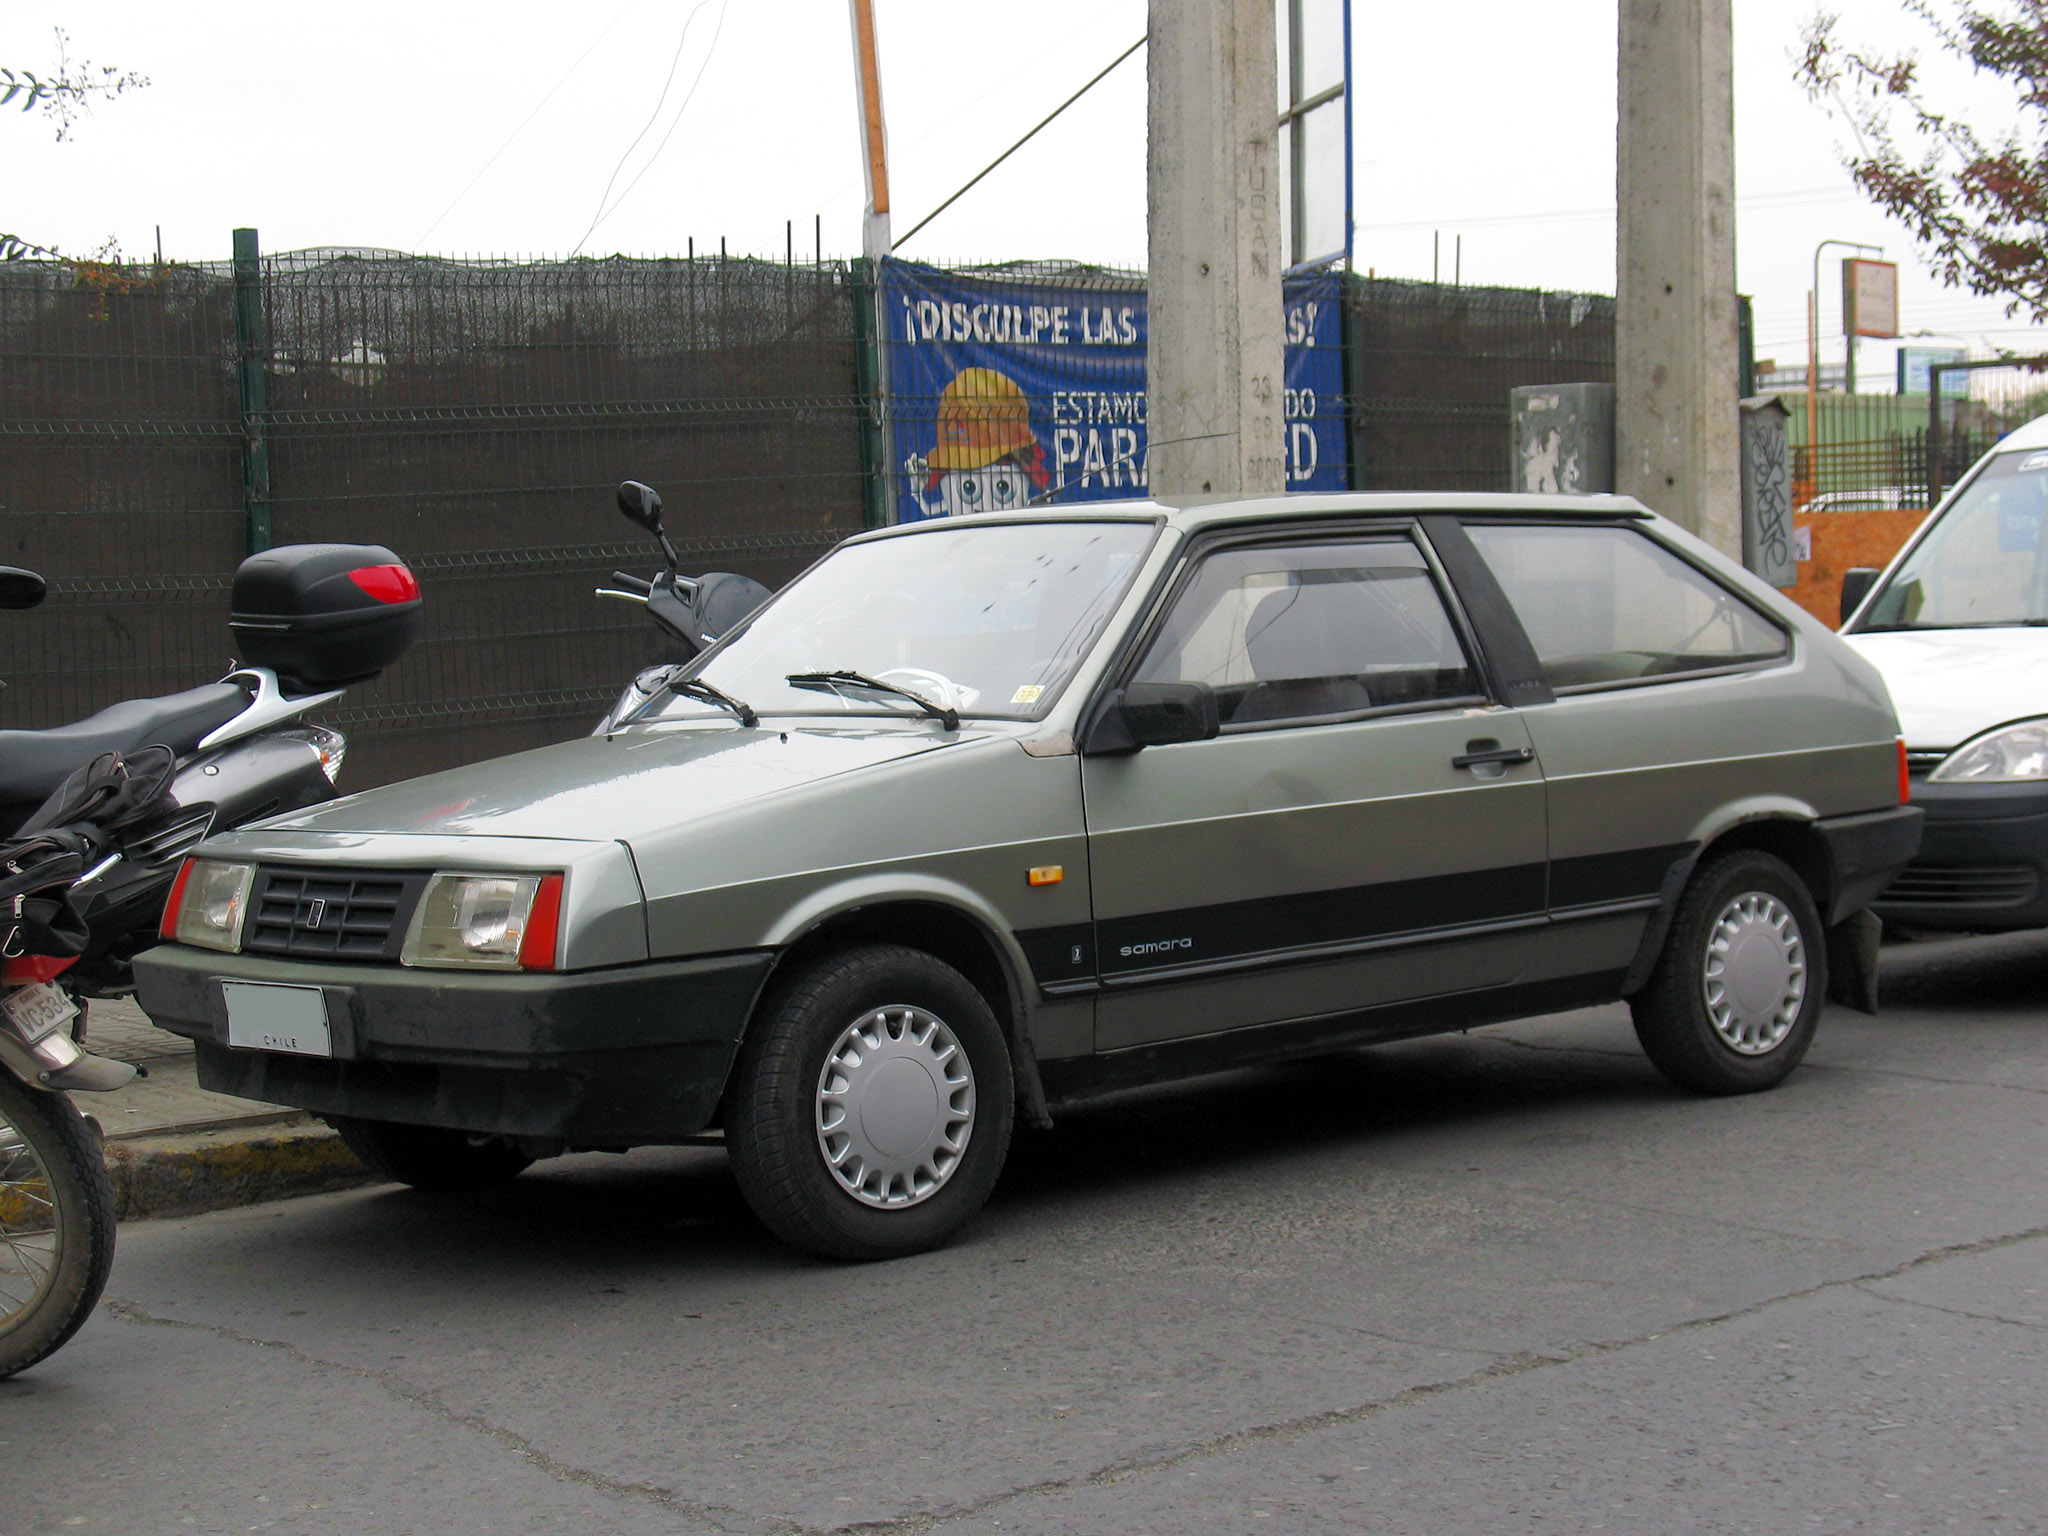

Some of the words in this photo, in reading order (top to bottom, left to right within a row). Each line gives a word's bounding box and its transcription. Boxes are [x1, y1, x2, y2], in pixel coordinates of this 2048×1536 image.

[903, 295, 1069, 346] ¡DISCULPE
[1081, 307, 1138, 344] LAS
[1120, 937, 1192, 957] samara
[263, 1034, 298, 1049] CHILE
